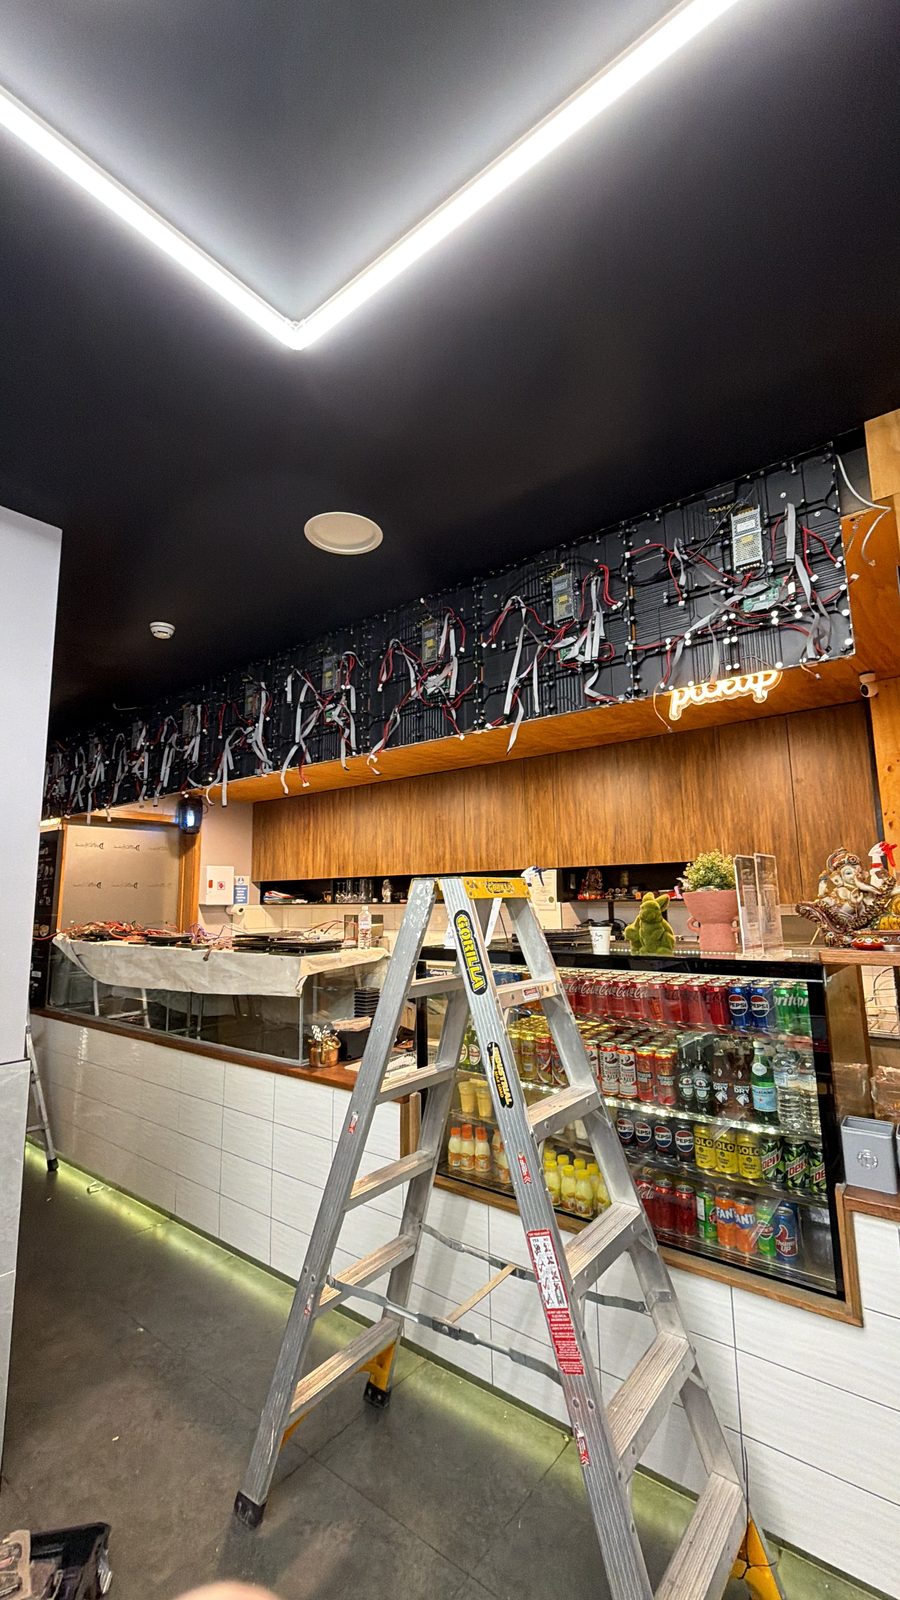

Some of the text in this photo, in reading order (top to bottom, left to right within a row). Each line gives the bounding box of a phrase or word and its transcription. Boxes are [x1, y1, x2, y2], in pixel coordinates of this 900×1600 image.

[669, 669, 780, 720] pickup
[455, 913, 485, 992] GORILLA
[695, 1138, 713, 1147] OLO
[716, 1142, 735, 1152] OLO
